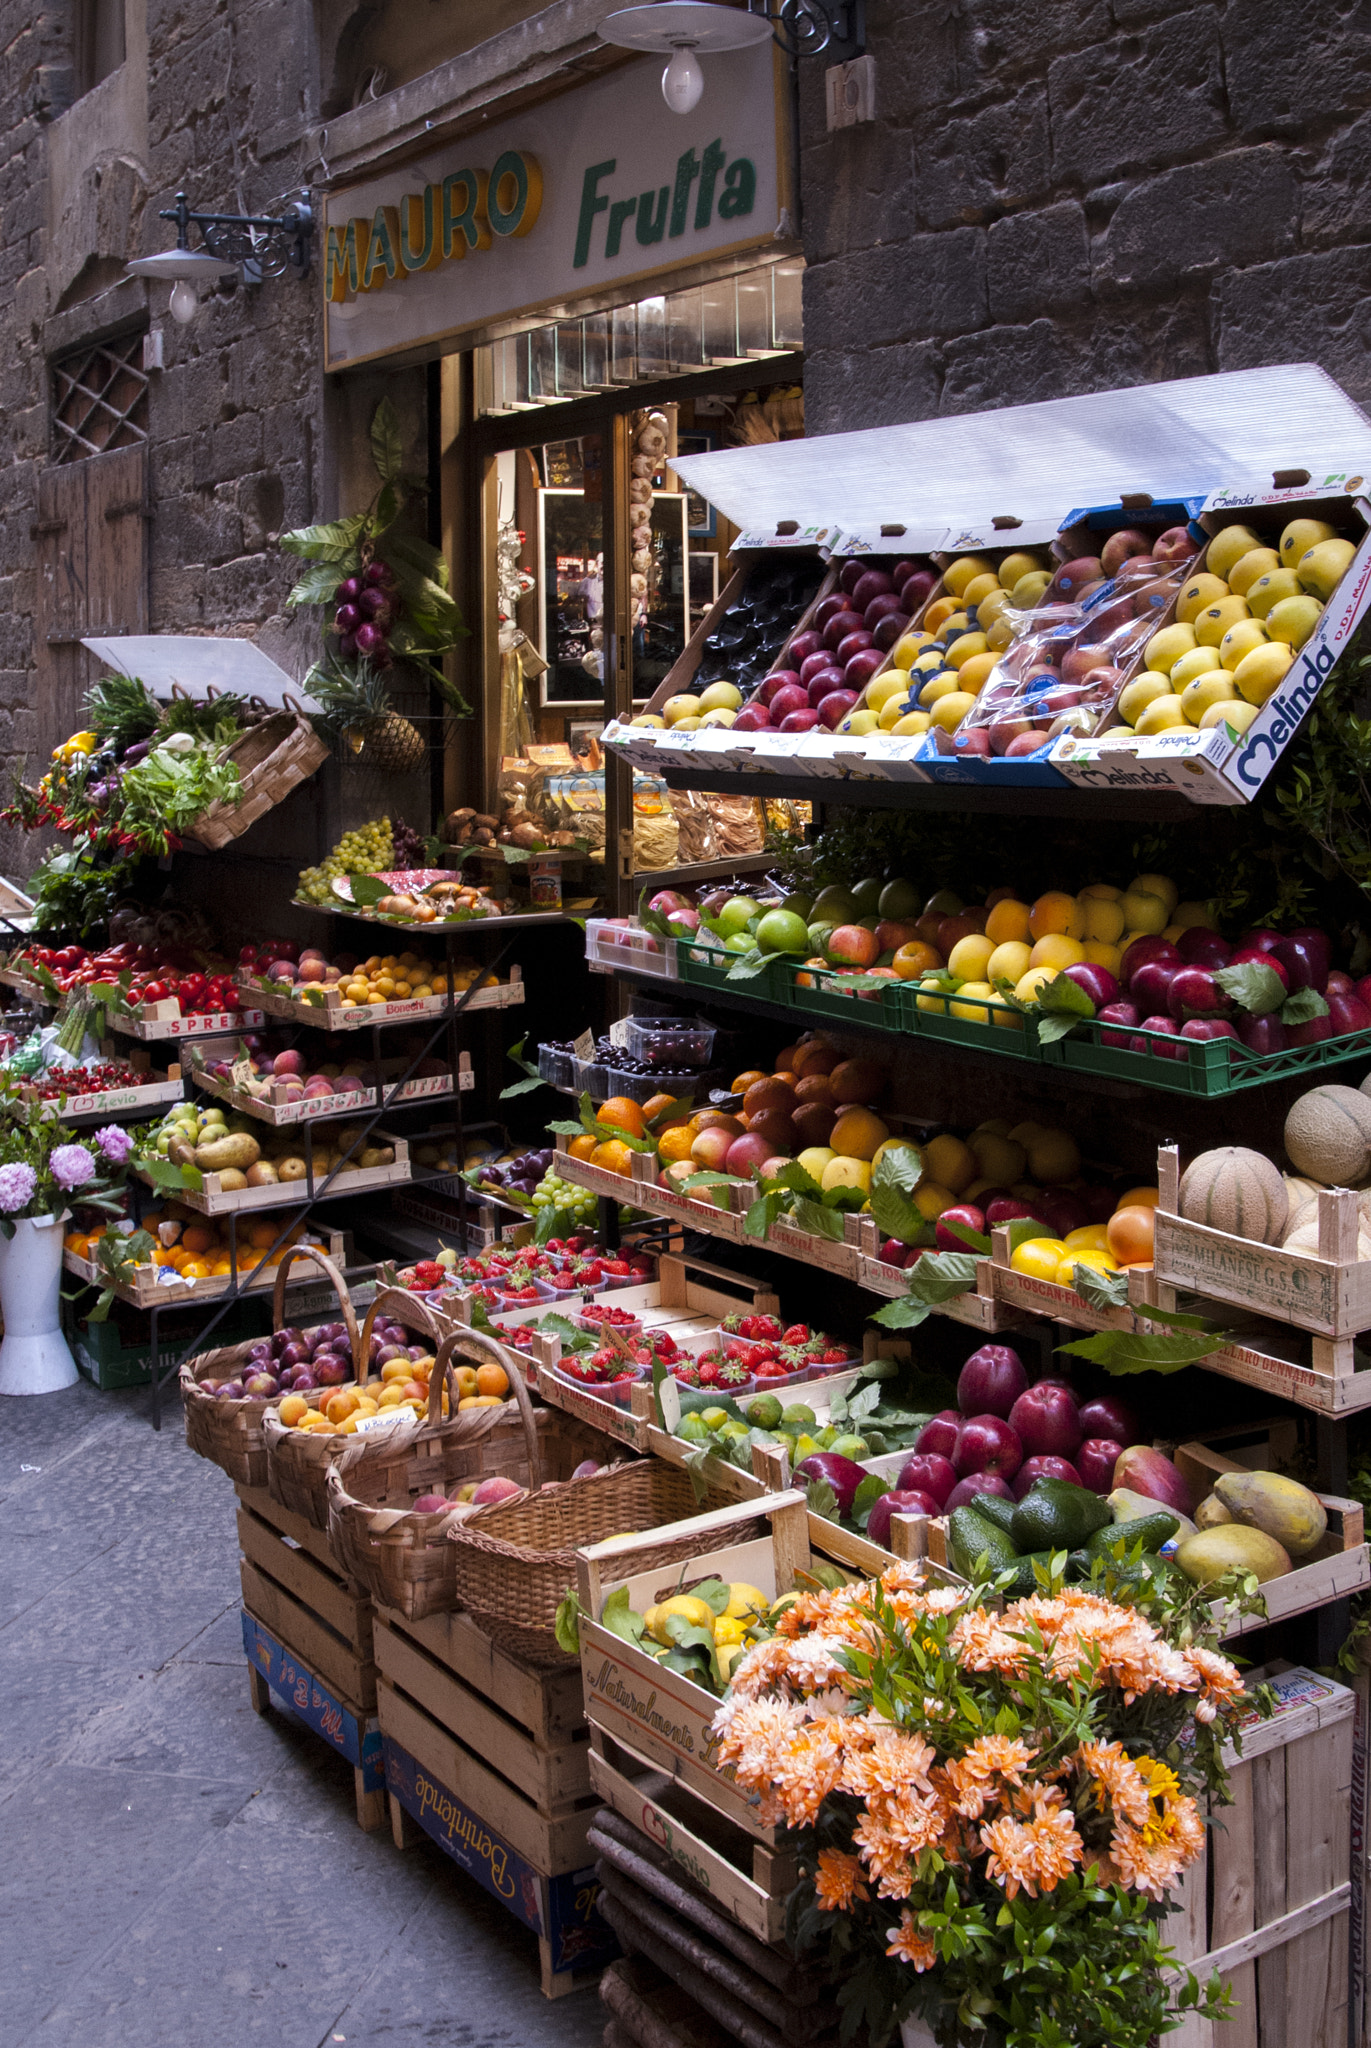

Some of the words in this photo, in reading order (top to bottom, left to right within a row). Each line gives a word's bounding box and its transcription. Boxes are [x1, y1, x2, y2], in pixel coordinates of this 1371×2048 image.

[325, 150, 543, 302] MAURO
[573, 137, 756, 268] Frutta
[1213, 494, 1255, 508] Melinda
[1237, 644, 1335, 786] Melinda
[1081, 766, 1175, 786] Melinda
[171, 1009, 262, 1033] SPREAF
[386, 999, 424, 1016] Bonechi
[98, 1093, 137, 1109] Zevio
[1193, 1245, 1261, 1283] MILANESE
[1262, 1354, 1316, 1387] GENNARO
[590, 1659, 694, 1752] Naturalmente
[415, 1774, 515, 1898] Benintende
